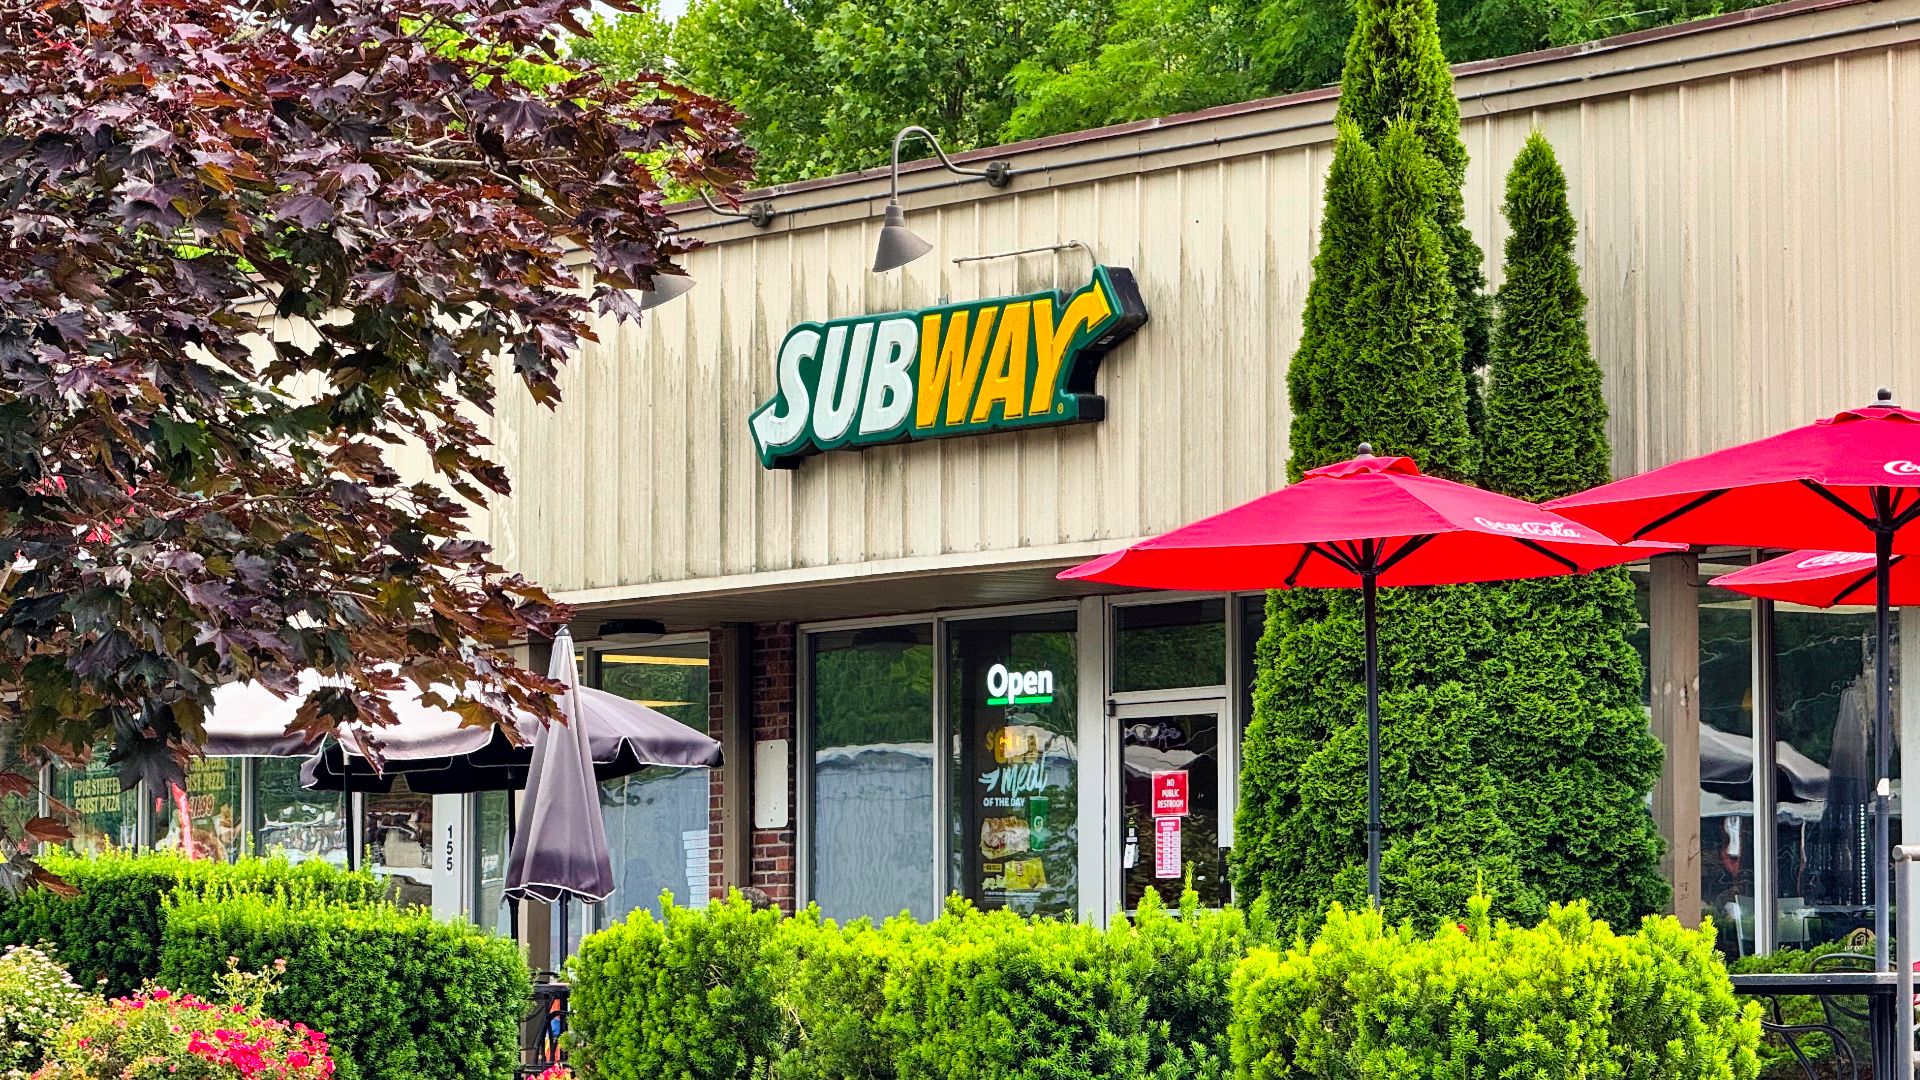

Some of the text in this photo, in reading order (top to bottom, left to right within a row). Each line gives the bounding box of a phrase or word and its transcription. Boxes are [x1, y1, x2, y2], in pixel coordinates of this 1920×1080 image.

[750, 279, 1112, 454] SUBWAY
[987, 663, 1053, 705] Open
[203, 772, 226, 791] PIZZA
[1166, 778, 1175, 787] NO
[983, 797, 1025, 807] OF THE DAY
[1161, 788, 1180, 798] PUBLIC
[75, 795, 121, 815] CRUST PIZZA
[1157, 799, 1184, 809] RESTROOM
[446, 824, 454, 872] 155
